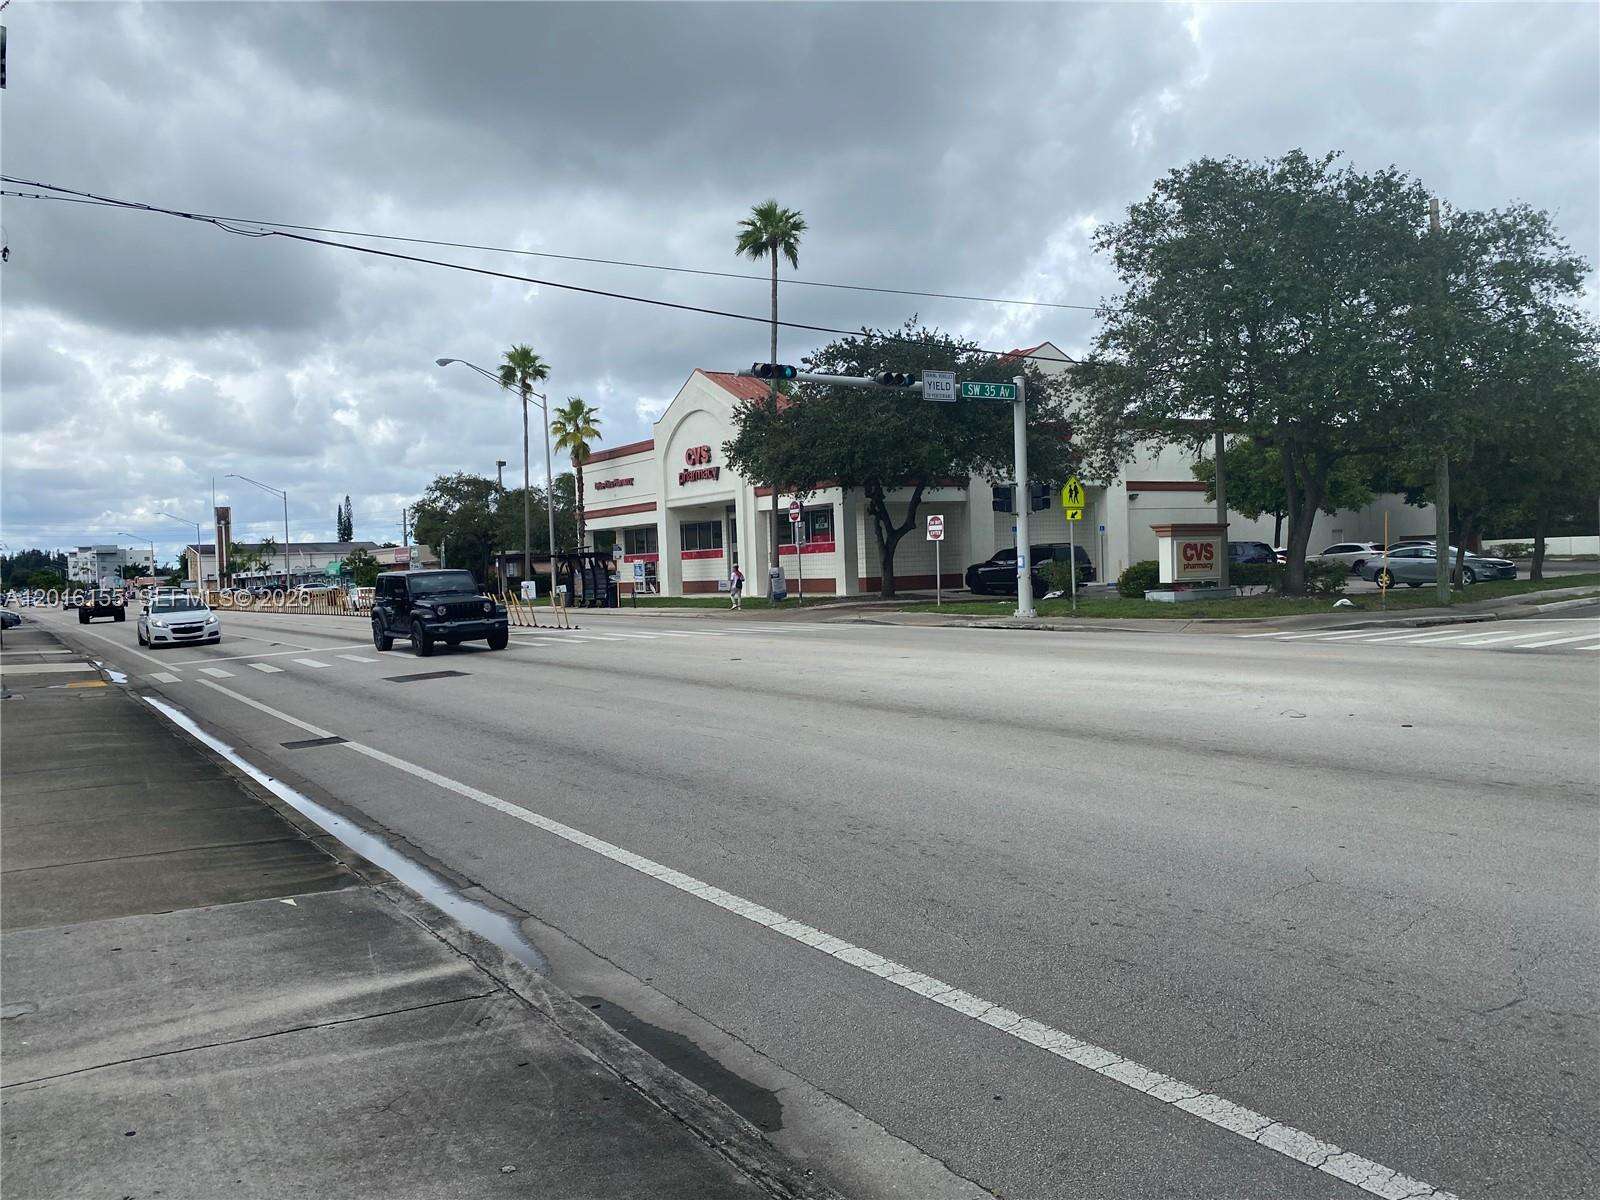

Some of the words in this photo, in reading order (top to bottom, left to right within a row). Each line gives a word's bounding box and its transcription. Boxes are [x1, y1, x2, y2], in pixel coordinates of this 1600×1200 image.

[927, 381, 951, 391] YIELD
[968, 384, 981, 396] SW
[984, 385, 996, 397] 35
[685, 445, 711, 466] CVS
[678, 467, 720, 487] pharmacy
[1182, 543, 1214, 561] CVS
[1183, 562, 1214, 570] pharmacy
